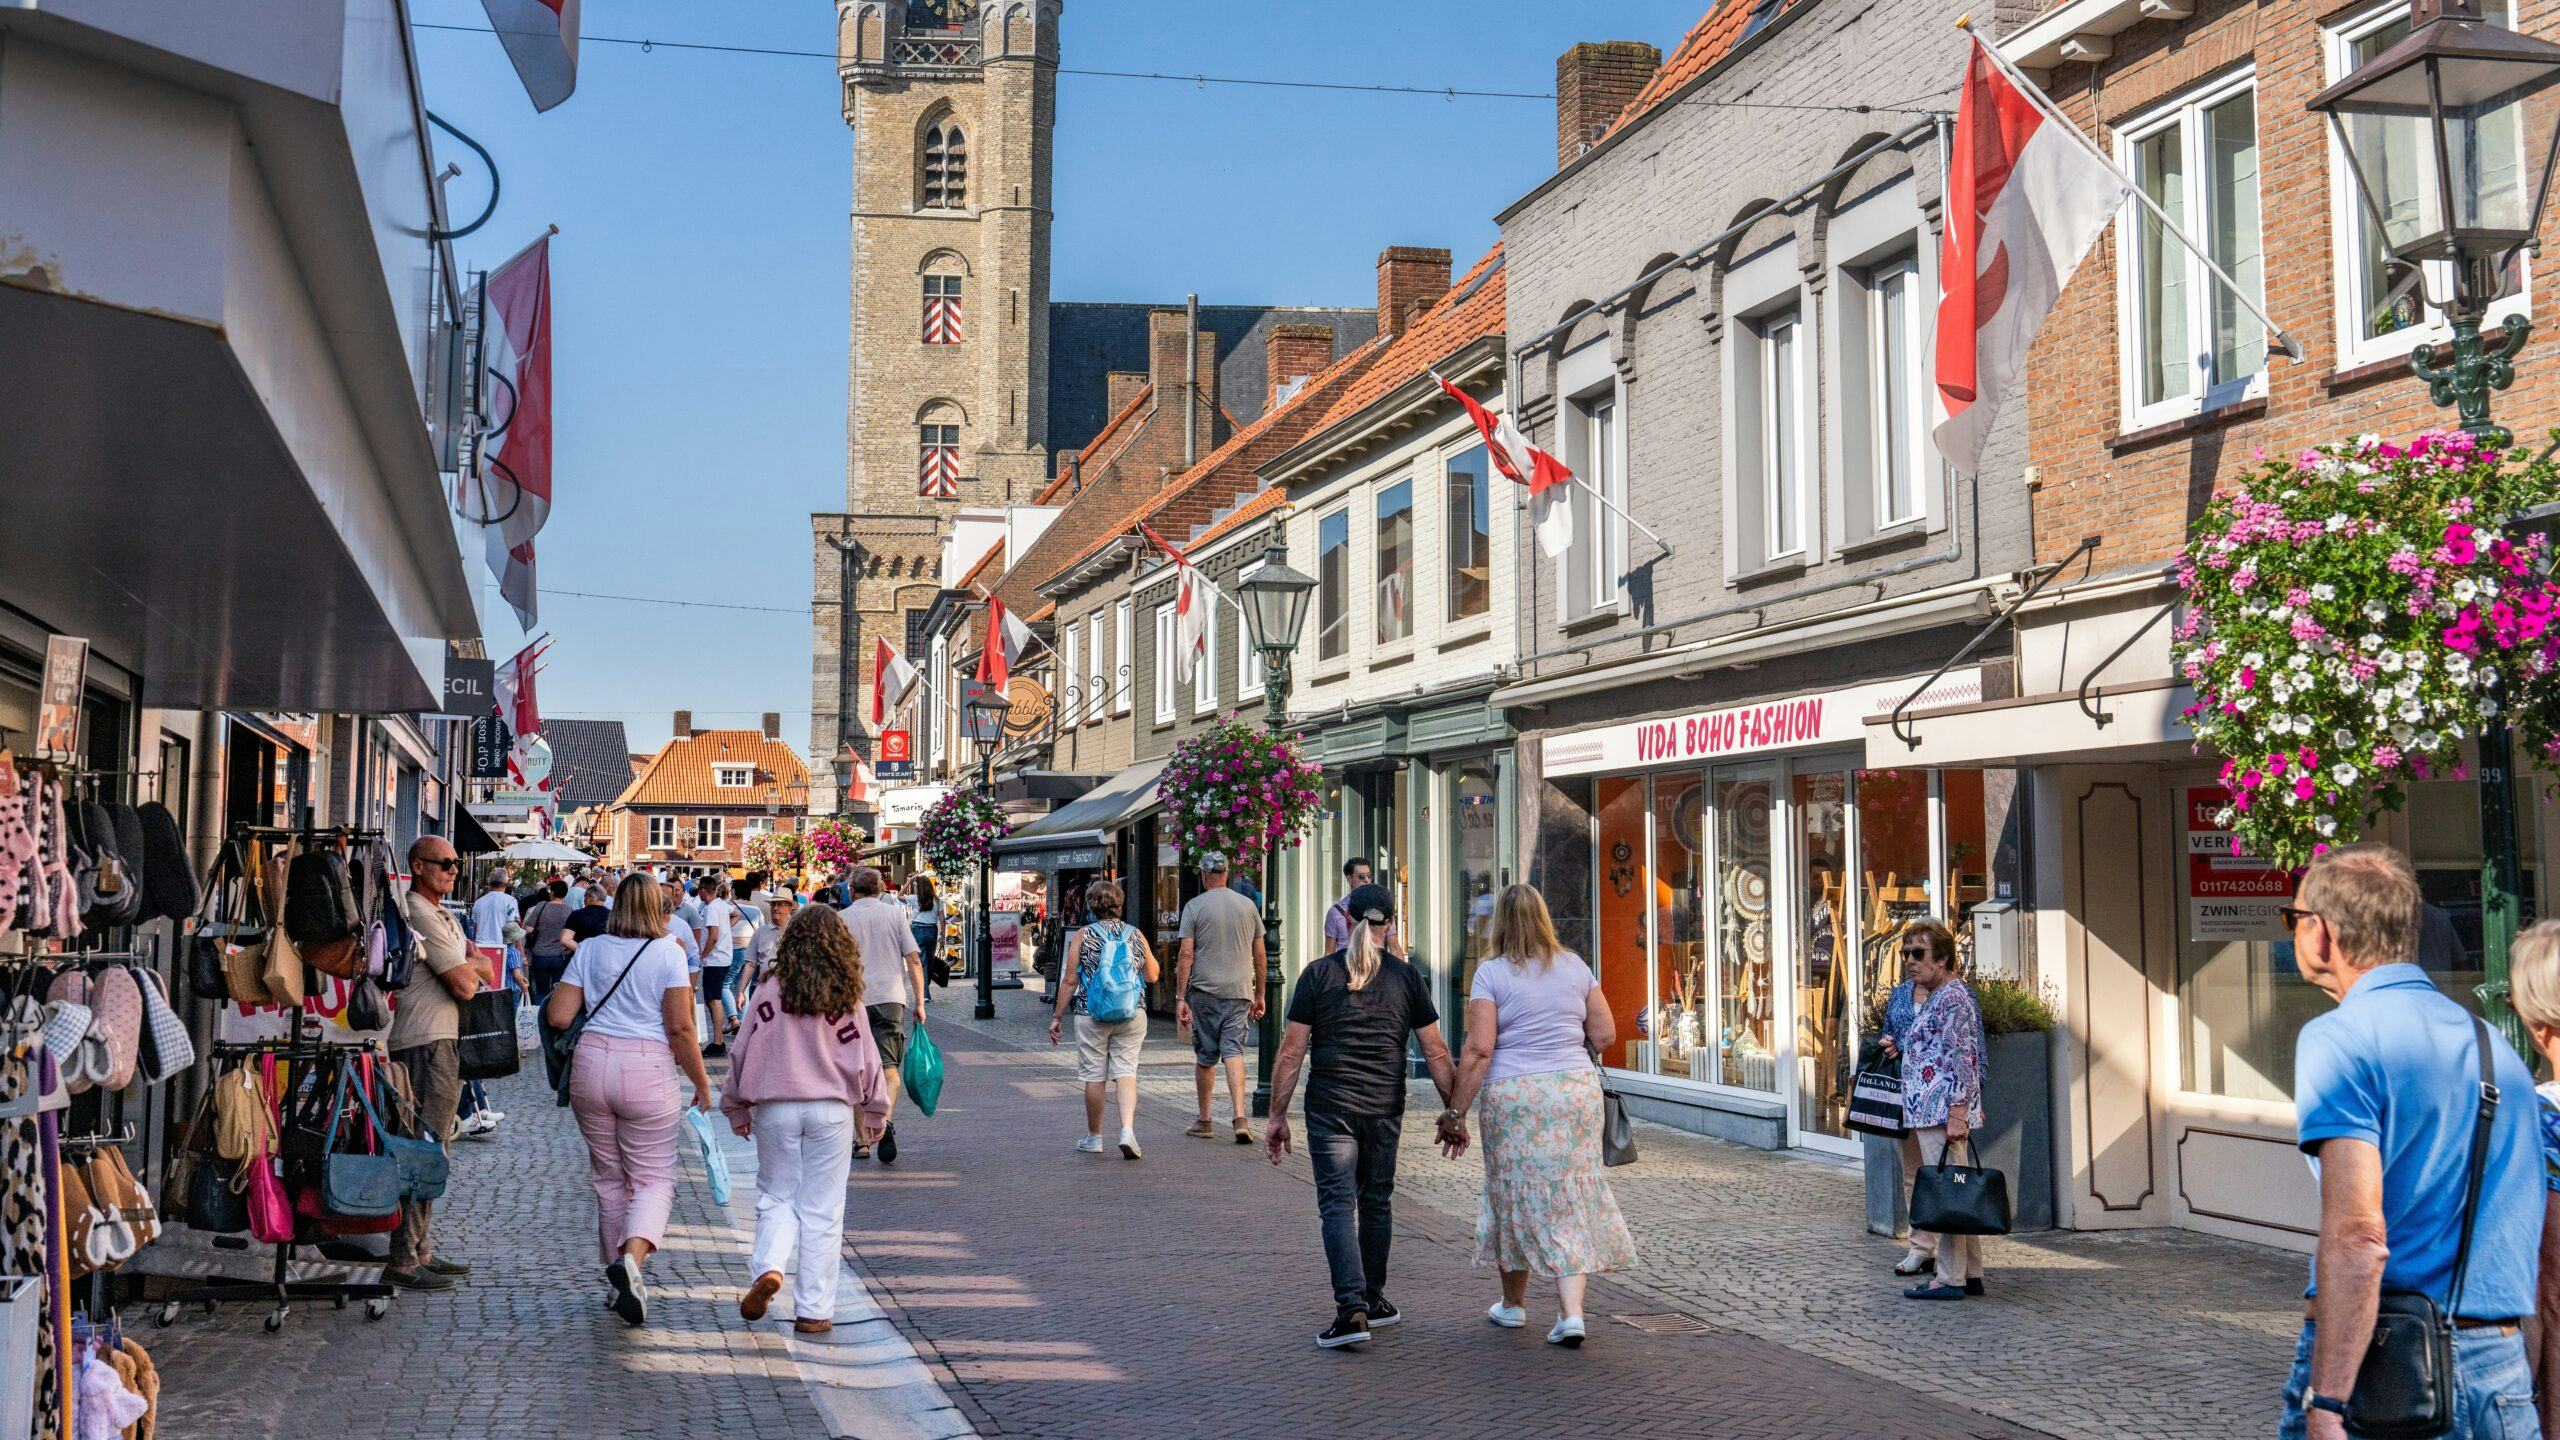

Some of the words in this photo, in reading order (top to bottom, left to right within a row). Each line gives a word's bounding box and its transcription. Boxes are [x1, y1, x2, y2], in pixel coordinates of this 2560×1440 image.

[444, 677, 483, 696] ECIL
[1637, 721, 1677, 762] VIDA
[1685, 712, 1735, 756] BOHO
[1739, 697, 1823, 748] FASHION
[2481, 767, 2501, 783] 99
[891, 802, 924, 813] Tamaris
[2200, 880, 2283, 892] 0117420688
